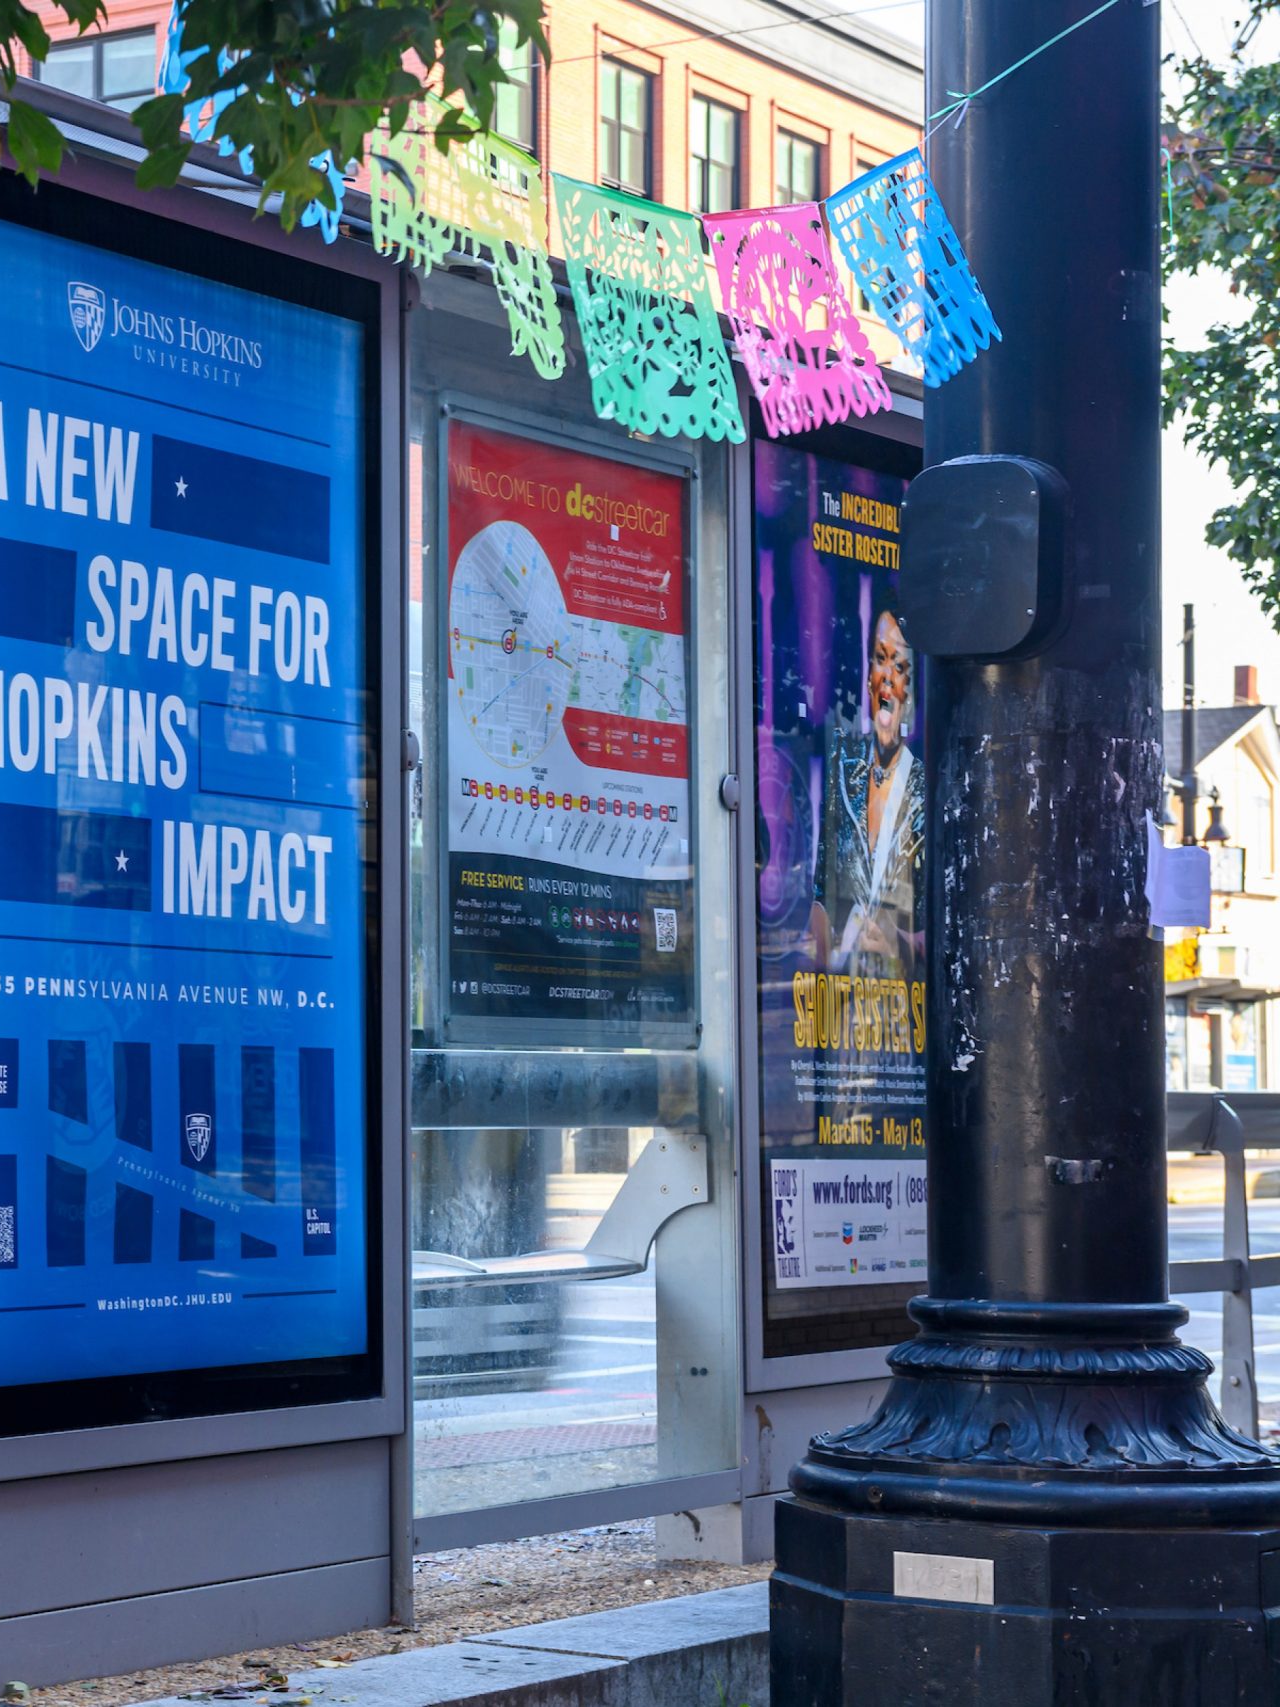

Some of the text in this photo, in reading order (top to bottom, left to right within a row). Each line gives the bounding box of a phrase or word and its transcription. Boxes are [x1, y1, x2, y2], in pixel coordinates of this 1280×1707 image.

[111, 298, 262, 368] JOHNS HOPKINS
[133, 345, 242, 387] UNIVERSITY
[25, 407, 140, 525] NEW
[451, 462, 669, 537] WELCOME TO dcstreetcar
[823, 491, 841, 517] The
[813, 522, 853, 558] SISTER
[86, 555, 331, 688] SPACE FOR
[163, 820, 333, 925] IMPACT
[461, 870, 612, 899] FREE SERVICE RUNS EVERY 12 MINS
[25, 977, 168, 1002] PENNSYLVANIA
[178, 985, 249, 1005] AVENUE
[258, 988, 289, 1009] NW,
[297, 991, 335, 1008] D.C.
[792, 970, 851, 1050] SHOUT
[853, 976, 911, 1053] SISTER
[818, 1116, 858, 1145] March
[860, 1119, 872, 1145] 15
[883, 1117, 908, 1150] May
[911, 1118, 926, 1148] 13,
[774, 1169, 797, 1197] FORD'S
[813, 1174, 893, 1209] www.fords.org
[306, 1209, 319, 1221] U.S.
[306, 1221, 331, 1235] CAPITOL
[778, 1257, 801, 1278] THEATRE
